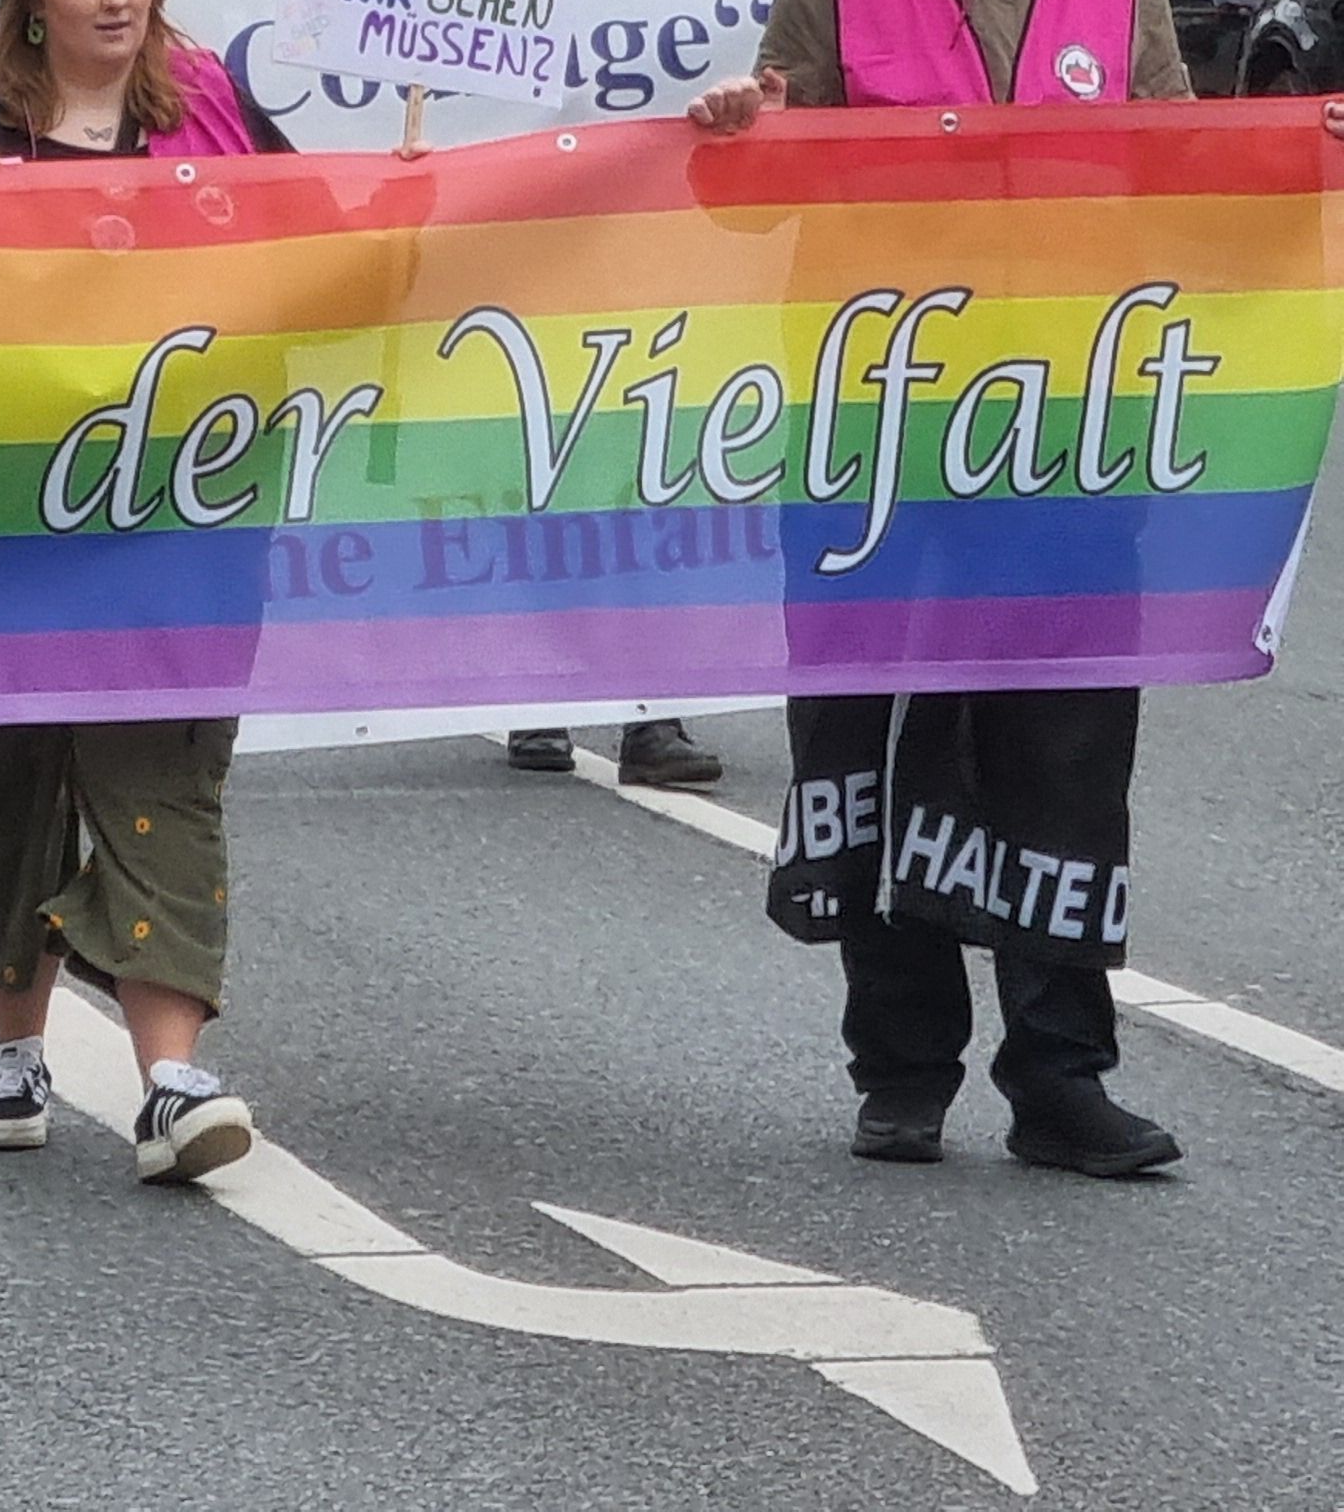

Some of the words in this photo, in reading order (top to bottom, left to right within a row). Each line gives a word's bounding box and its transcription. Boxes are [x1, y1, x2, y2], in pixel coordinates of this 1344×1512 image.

[359, 8, 557, 96] MÜSSEN?
[39, 325, 384, 536] der
[436, 280, 1223, 577] Vielfalt
[895, 805, 1096, 940] HALTE
